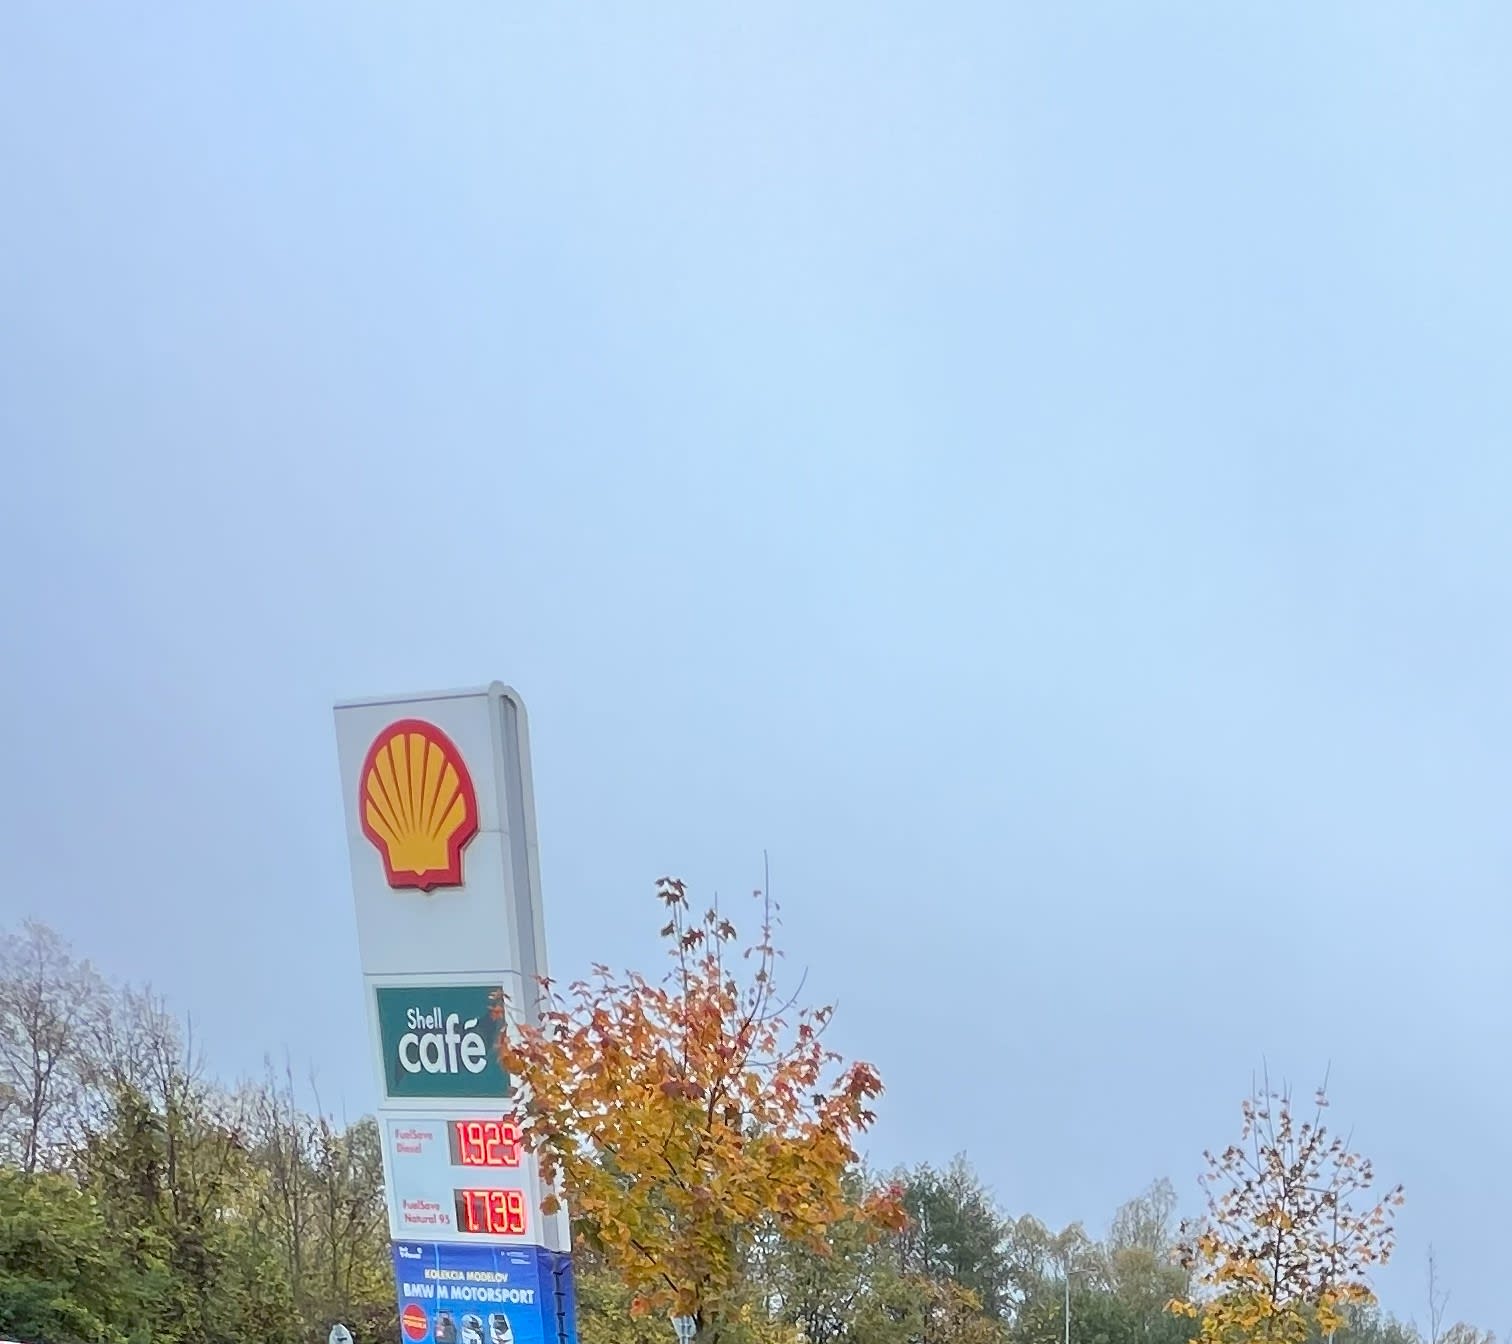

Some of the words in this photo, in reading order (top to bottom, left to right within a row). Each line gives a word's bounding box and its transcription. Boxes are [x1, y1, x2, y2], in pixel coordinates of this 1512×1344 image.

[407, 1007, 443, 1030] Shell
[399, 1013, 487, 1074] café
[394, 1128, 433, 1140] FuelSave
[396, 1142, 422, 1154] Diesel
[403, 1199, 440, 1211] FuelSave
[404, 1213, 437, 1224] Natural
[439, 1214, 451, 1225] 95
[403, 1283, 434, 1298] BMW
[436, 1285, 450, 1299] M
[451, 1286, 535, 1305] MOTORSPORT
